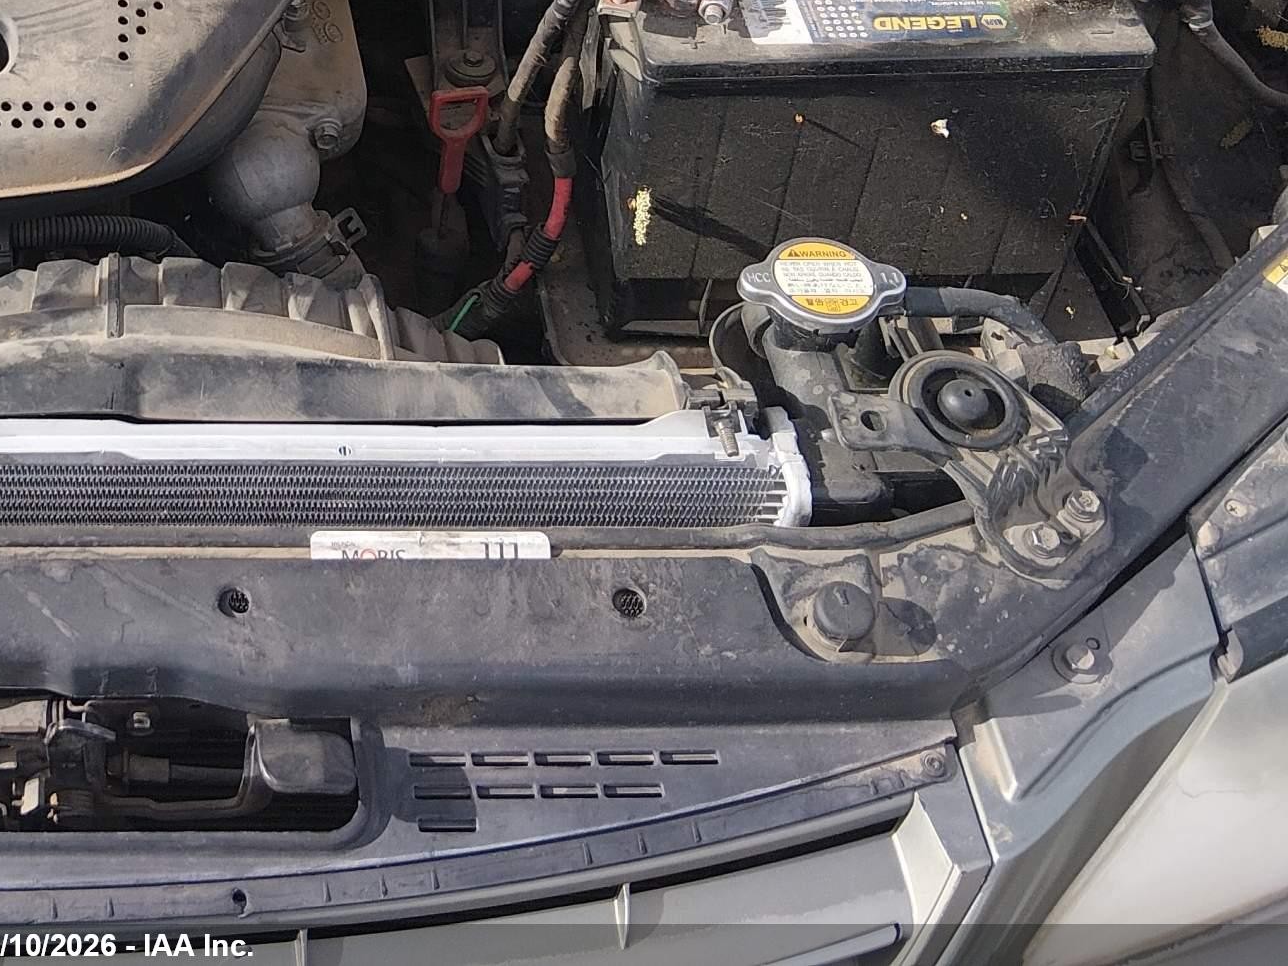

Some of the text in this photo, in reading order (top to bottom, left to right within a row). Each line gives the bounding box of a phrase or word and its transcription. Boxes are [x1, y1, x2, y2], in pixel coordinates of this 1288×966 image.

[873, 15, 978, 31] LEGEND
[799, 250, 847, 258] WARNING
[746, 272, 771, 283] HCC
[880, 272, 900, 284] 1.1
